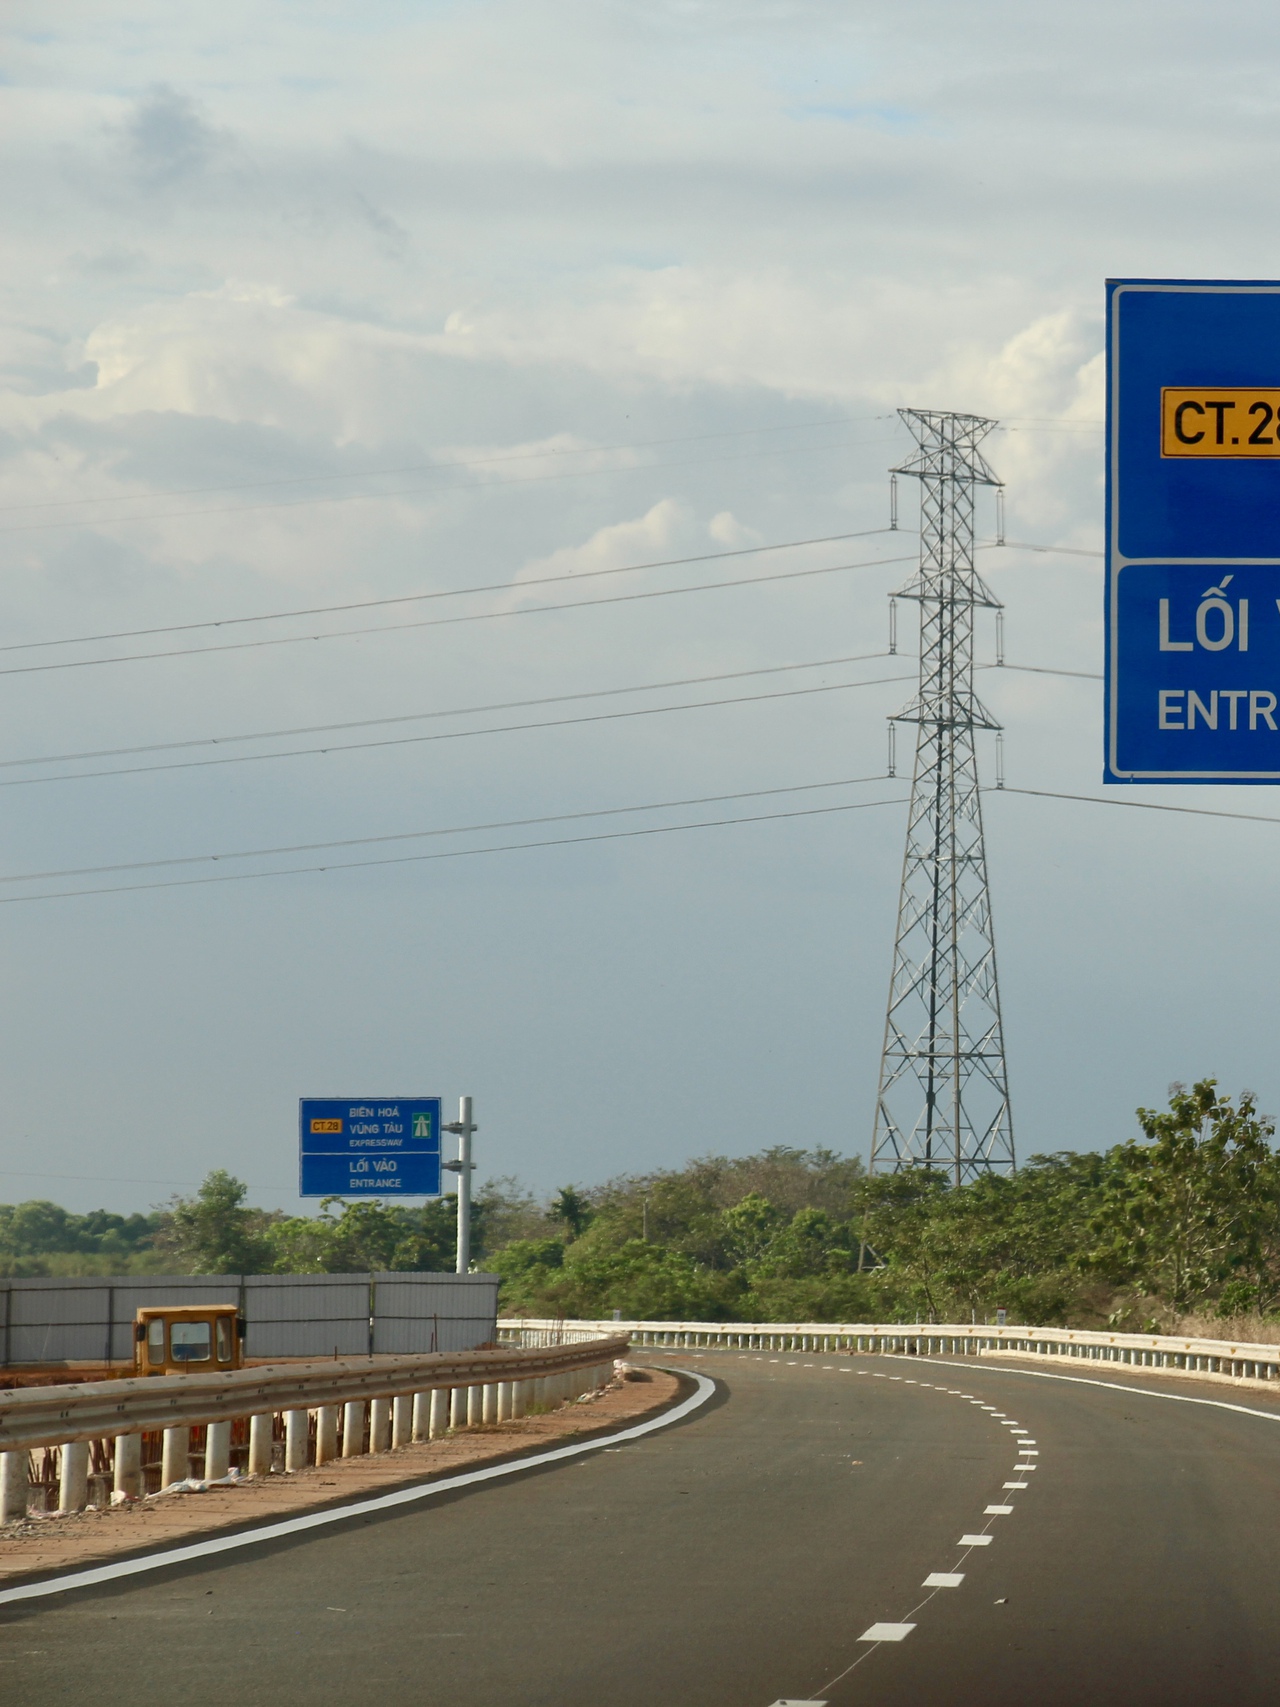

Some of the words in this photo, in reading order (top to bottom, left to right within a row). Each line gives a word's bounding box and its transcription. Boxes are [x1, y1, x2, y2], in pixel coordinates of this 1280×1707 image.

[1158, 575, 1249, 653] LỐI
[349, 1106, 374, 1118] BIÊN
[312, 1121, 339, 1132] CT.28
[349, 1138, 403, 1147] EXPRESSWAY
[349, 1178, 402, 1189] ENTRANCE
